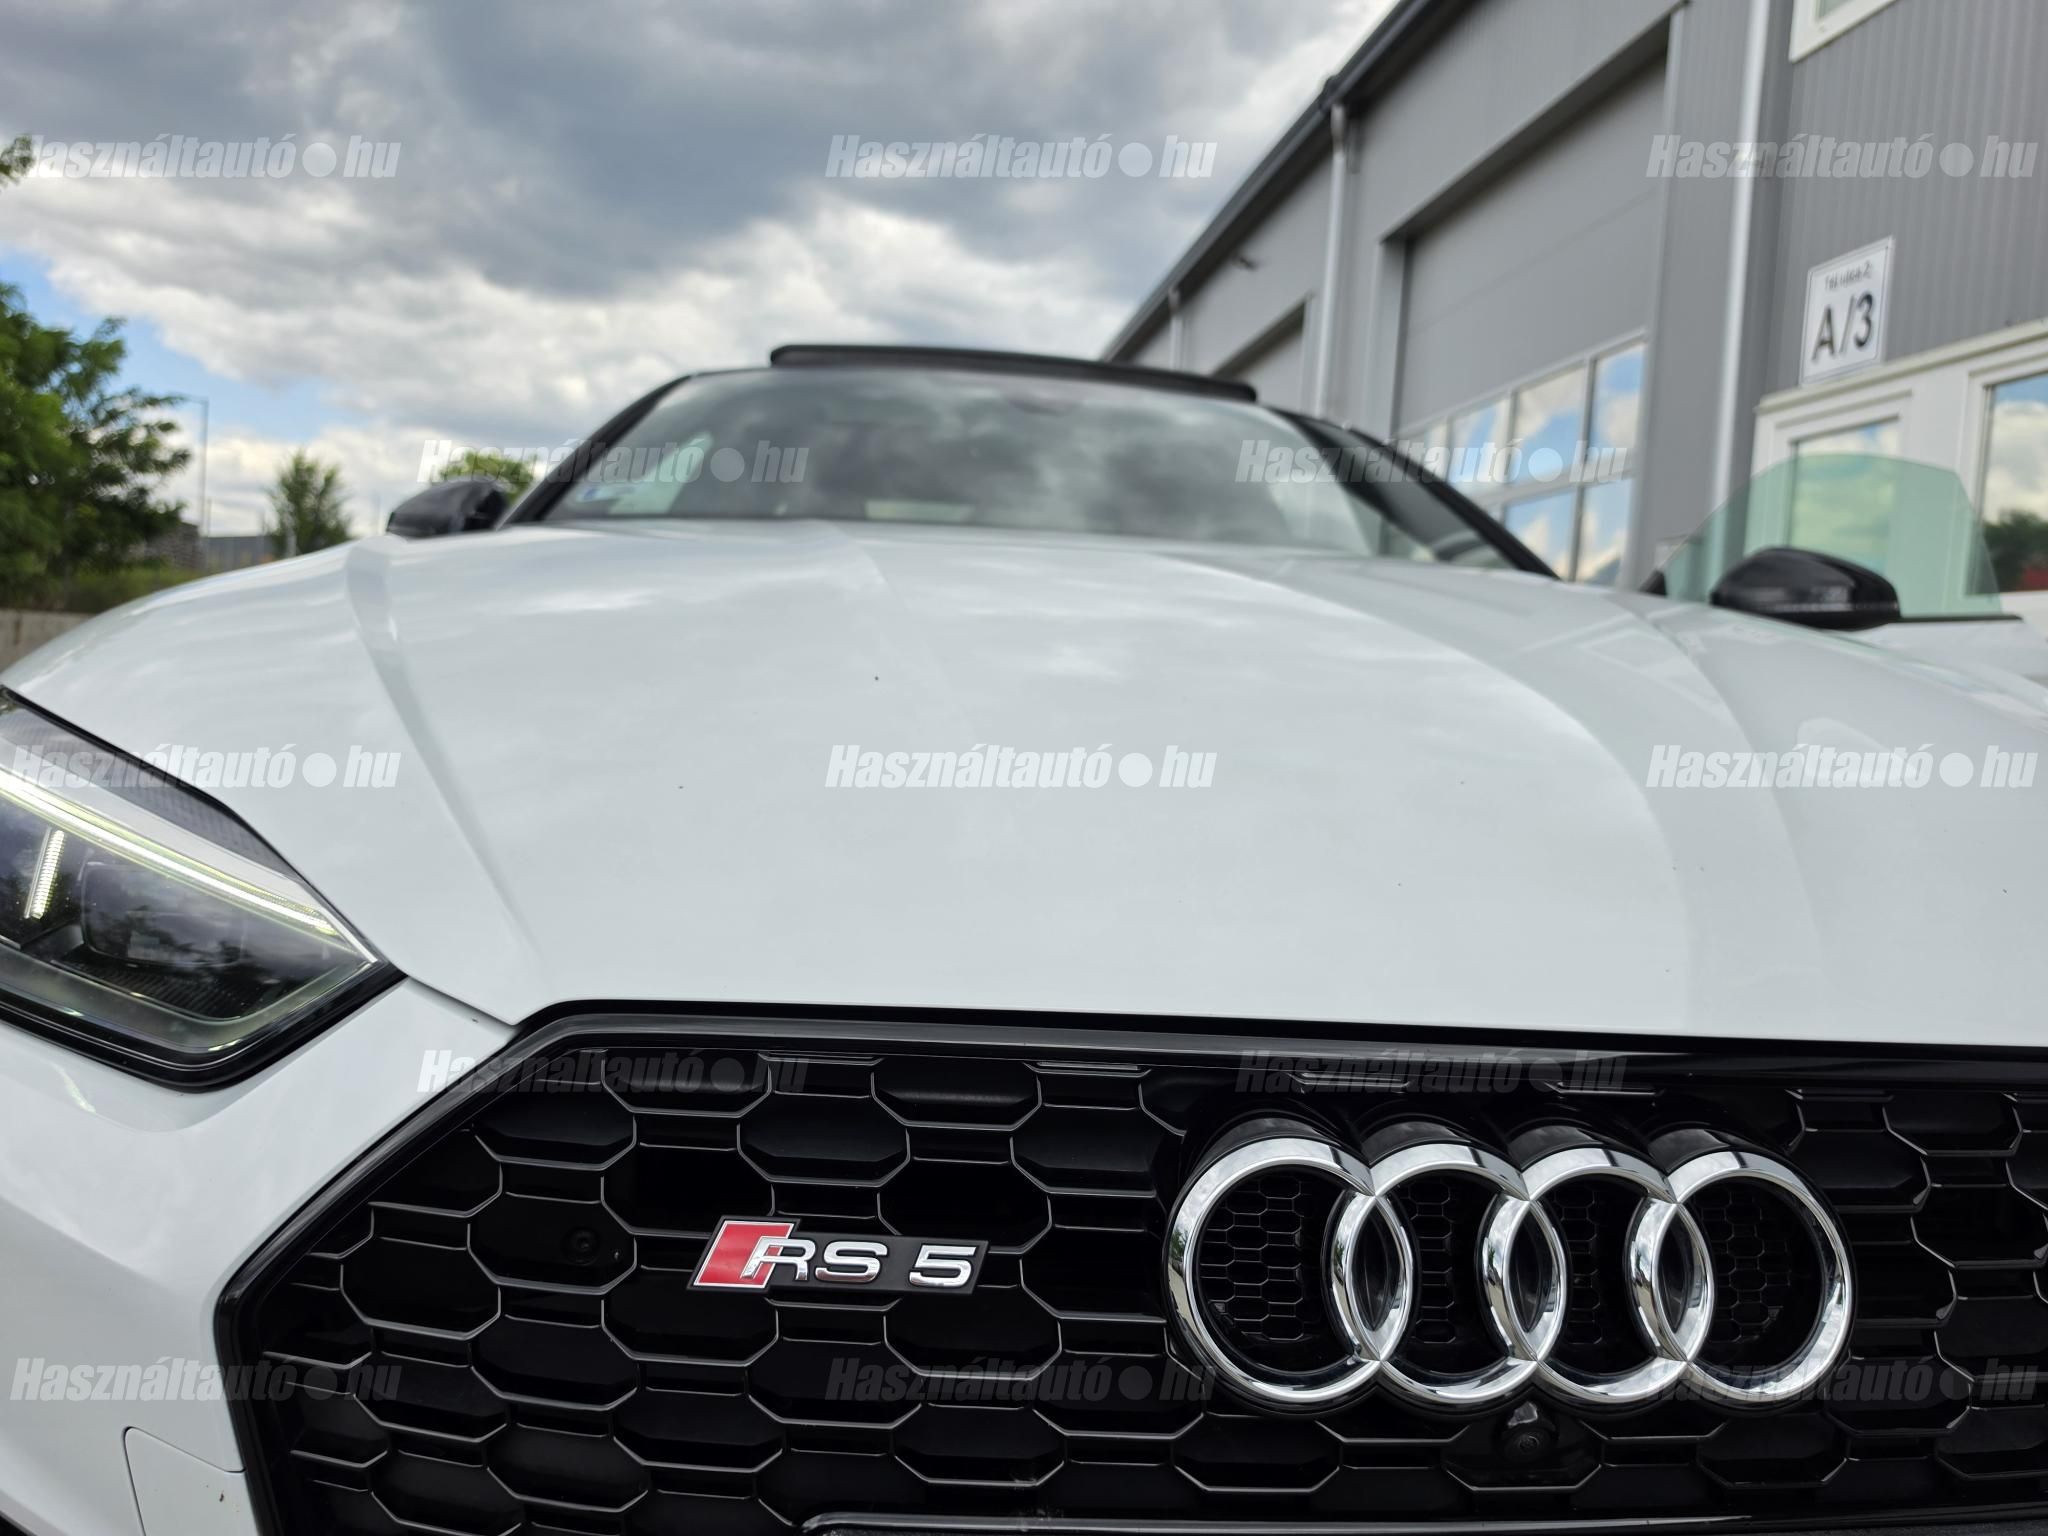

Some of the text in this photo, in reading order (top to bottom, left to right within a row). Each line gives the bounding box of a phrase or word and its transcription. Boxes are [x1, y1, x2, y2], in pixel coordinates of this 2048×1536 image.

[1812, 291, 1874, 361] A/3
[740, 1236, 977, 1288] RS 5
